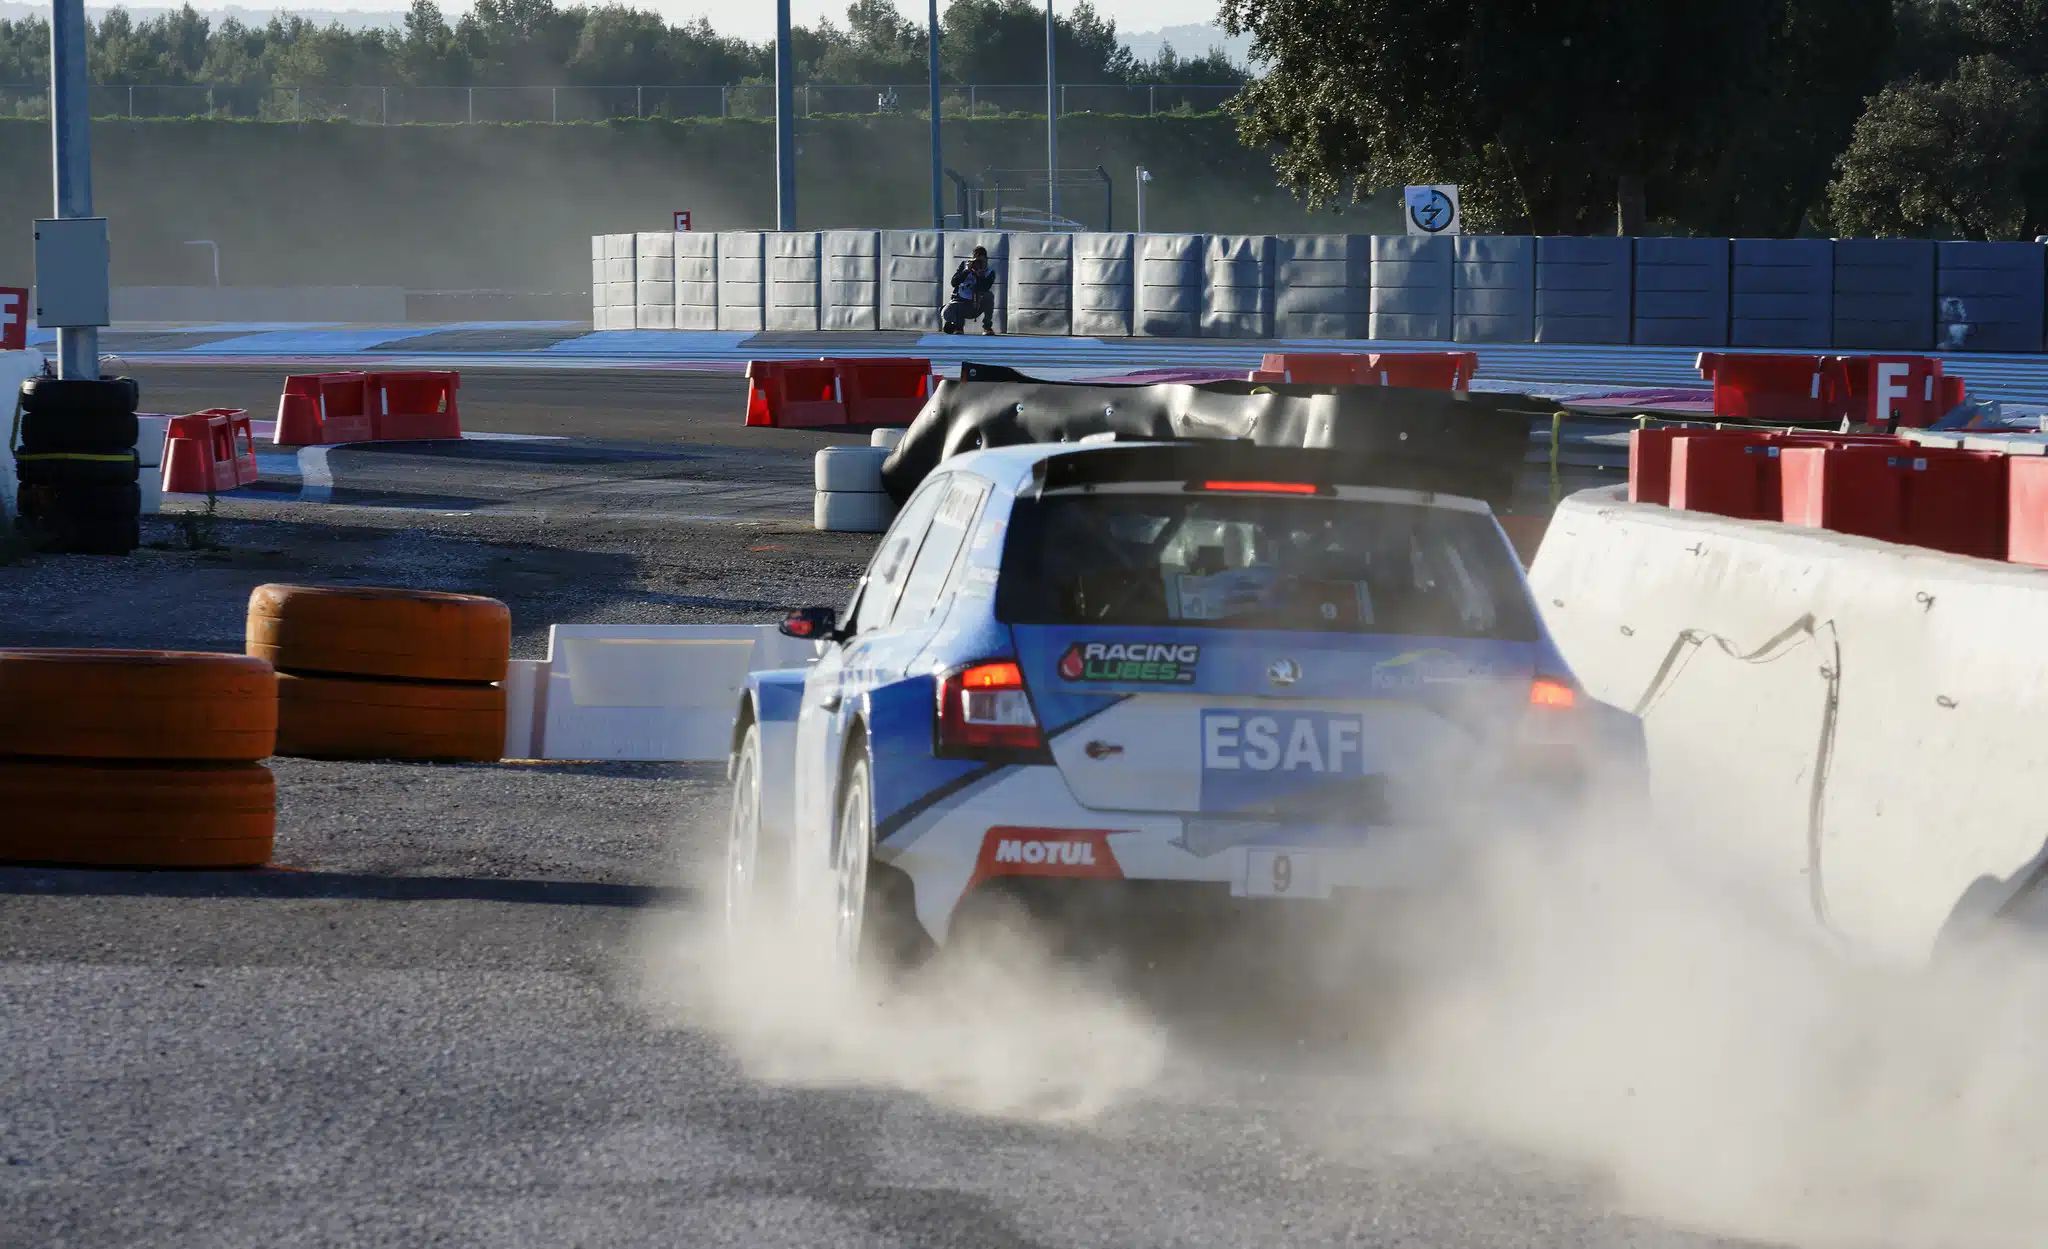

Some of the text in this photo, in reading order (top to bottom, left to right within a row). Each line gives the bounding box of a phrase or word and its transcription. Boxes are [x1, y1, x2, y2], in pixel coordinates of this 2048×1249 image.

[1876, 362, 1910, 419] F
[1084, 643, 1198, 663] RACING
[1085, 660, 1177, 680] LUBES
[1204, 715, 1362, 773] ESAF
[995, 838, 1097, 866] MOTUL
[1272, 854, 1293, 893] 9
